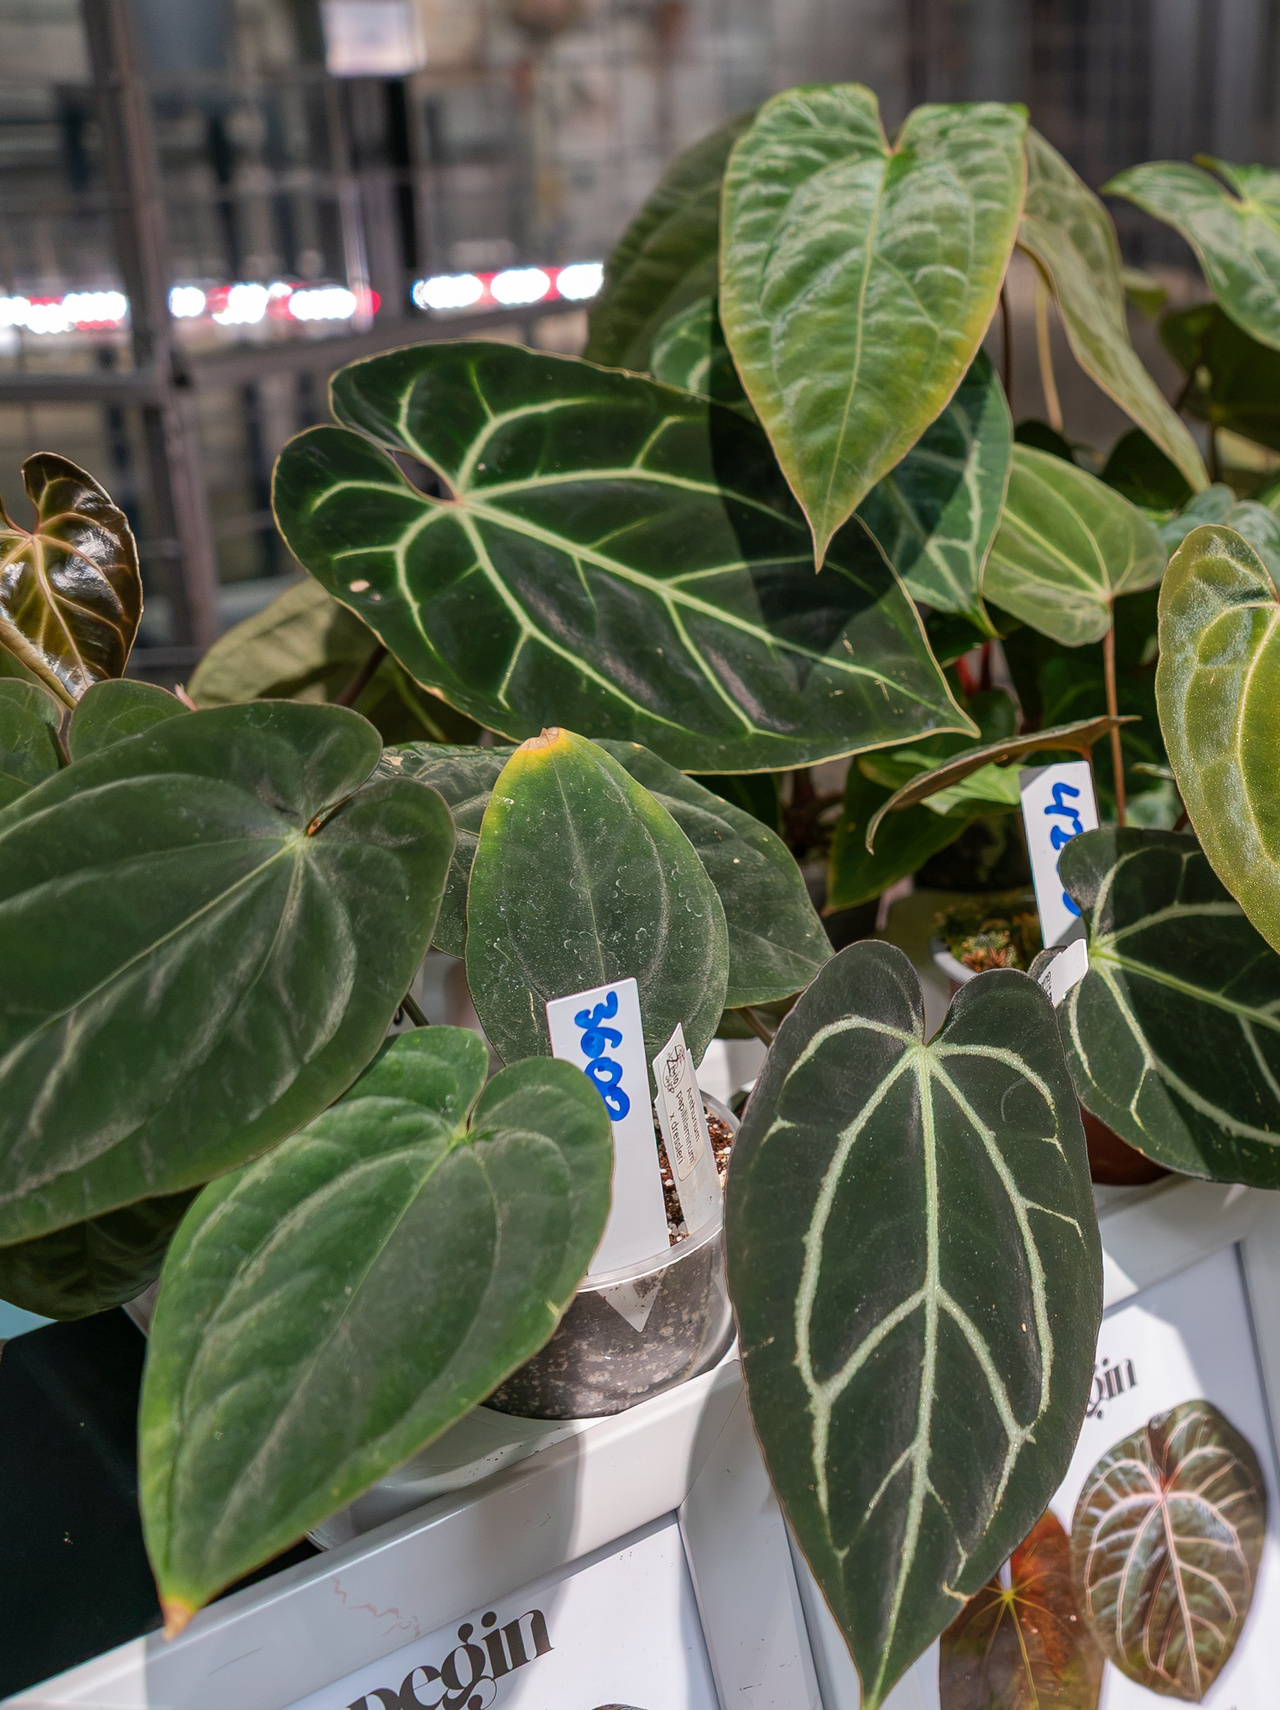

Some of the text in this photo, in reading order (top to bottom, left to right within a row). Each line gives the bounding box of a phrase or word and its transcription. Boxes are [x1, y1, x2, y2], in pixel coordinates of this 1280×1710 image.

[1044, 782, 1084, 917] 42
[686, 1087, 701, 1142] Anthurium
[671, 1121, 685, 1165] dressleri
